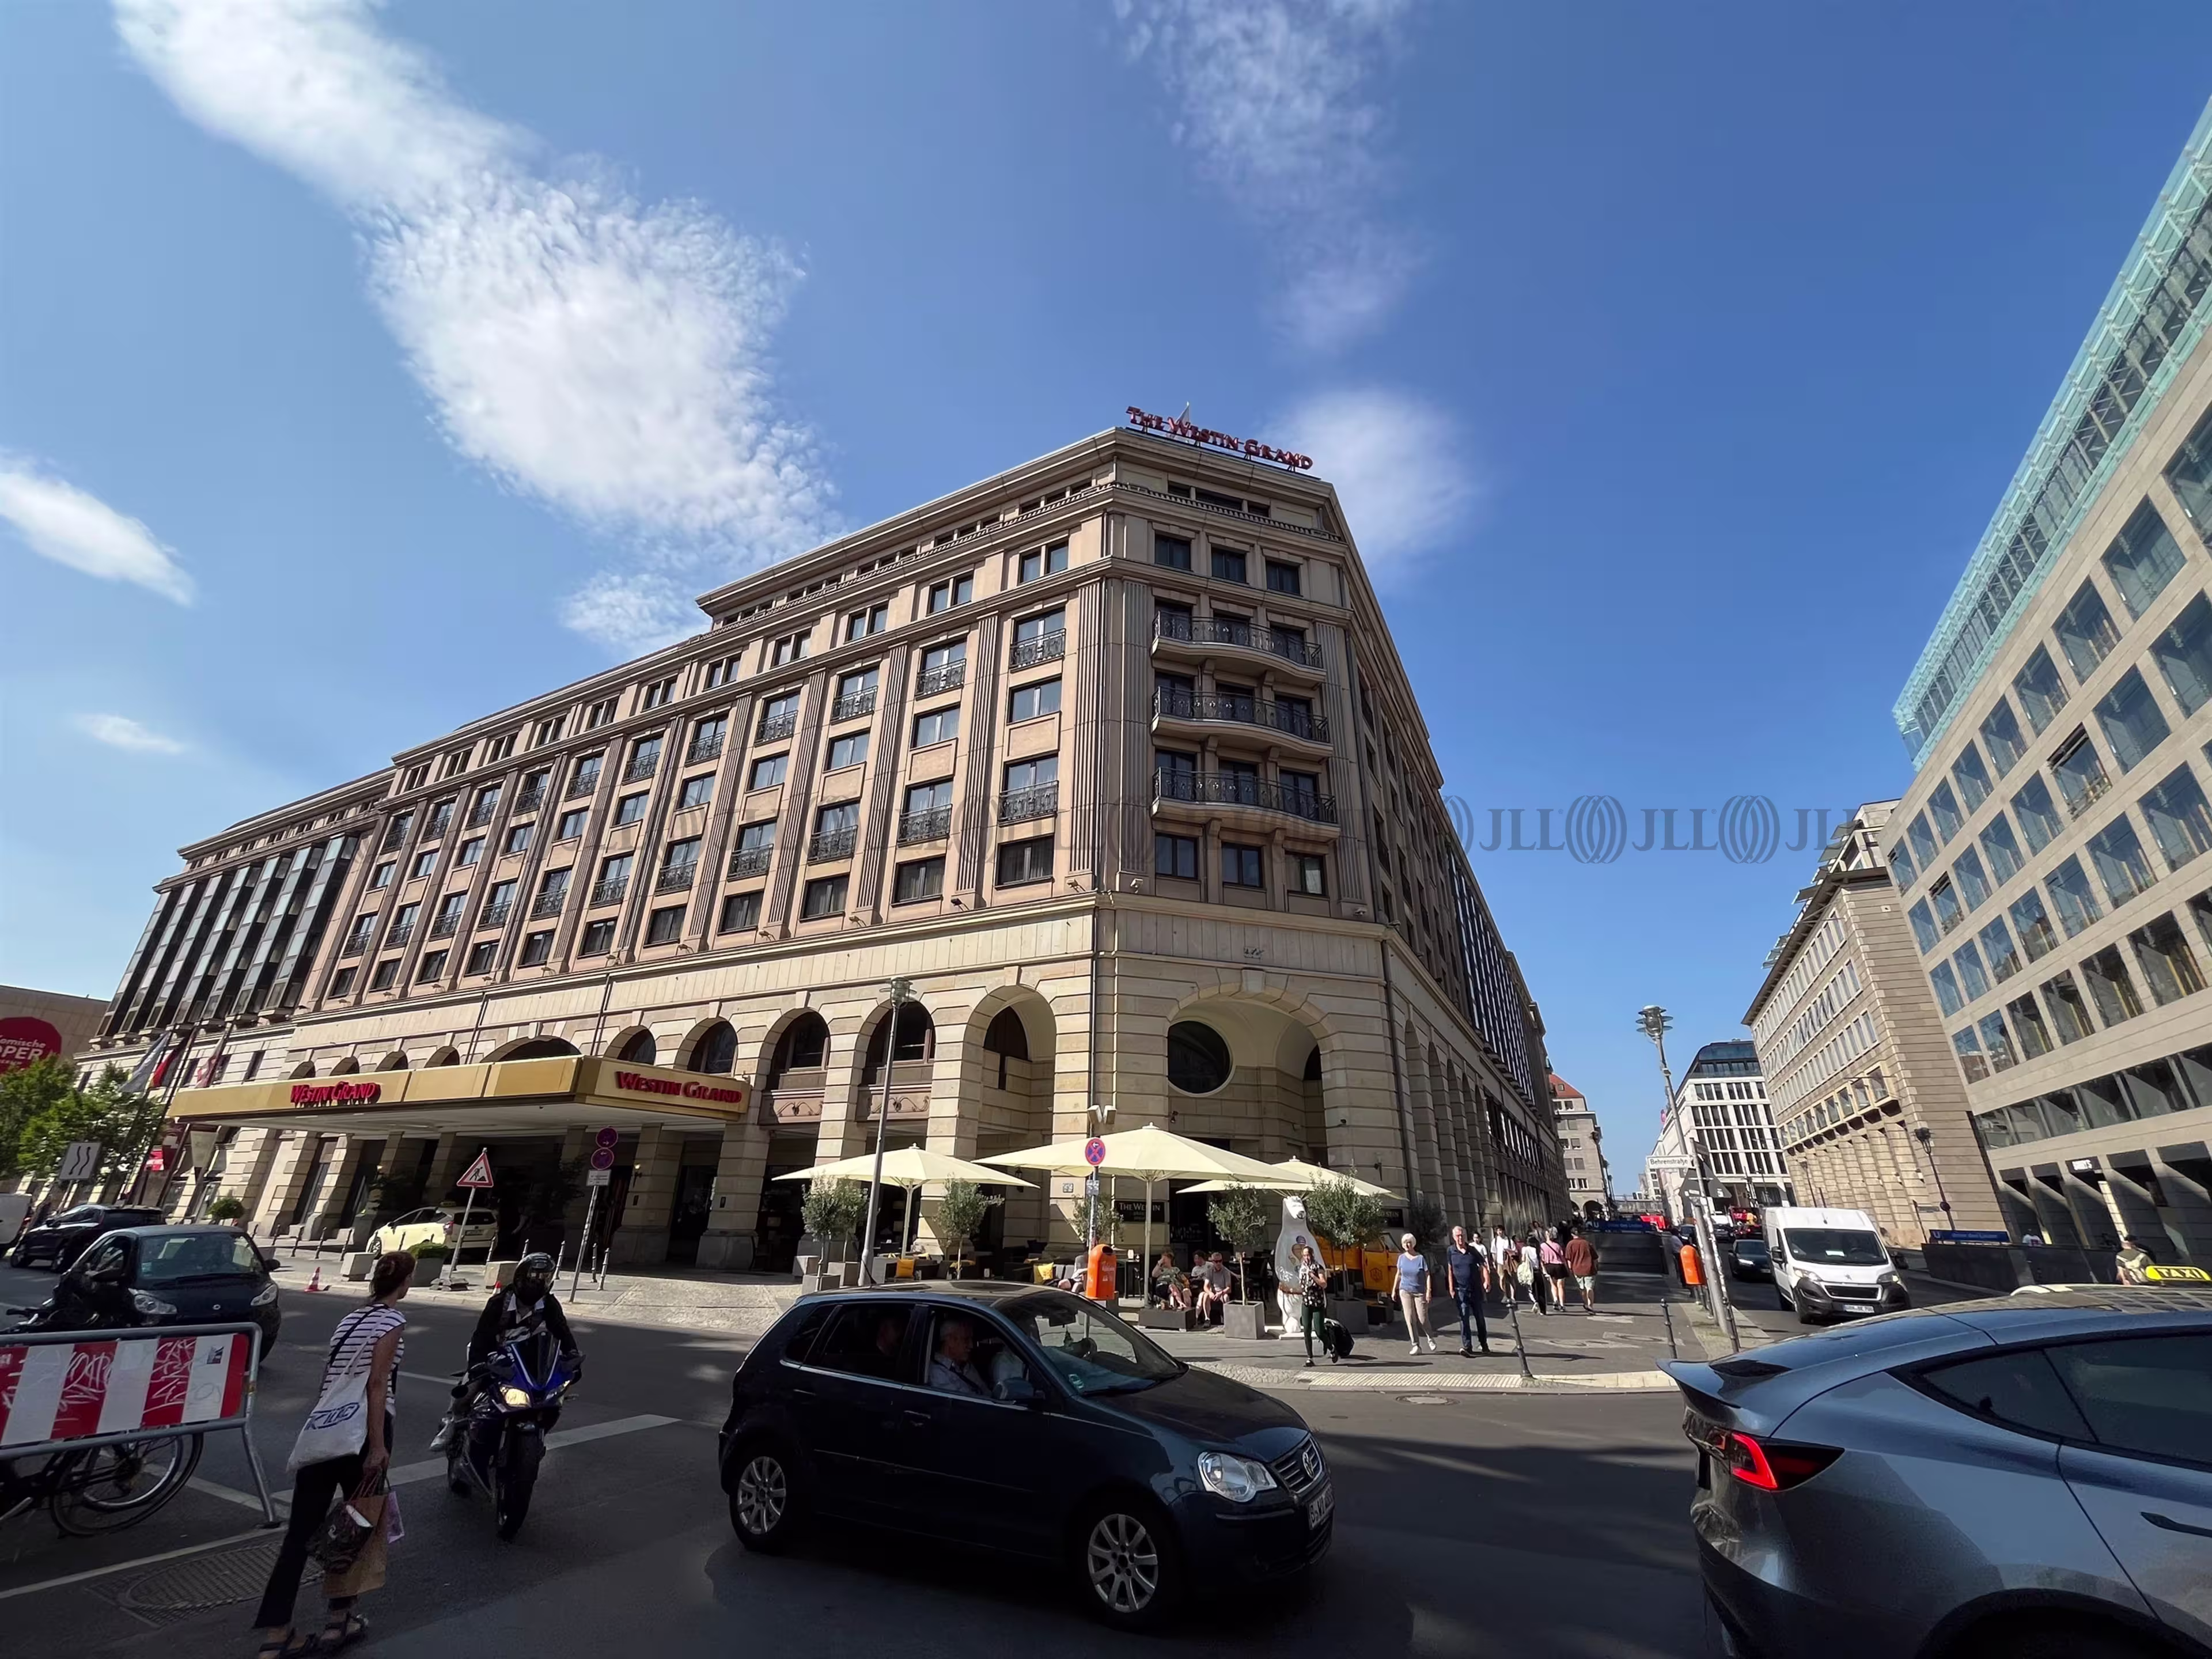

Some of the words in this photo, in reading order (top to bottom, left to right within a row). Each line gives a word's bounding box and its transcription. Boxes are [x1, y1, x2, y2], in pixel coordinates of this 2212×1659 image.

[1126, 406, 1164, 431] THE
[1167, 416, 1238, 450] WESTIN
[1244, 439, 1314, 470] GRAND
[0, 1035, 46, 1048] omische
[0, 1045, 43, 1060] PER
[331, 1081, 381, 1101] GRAND
[616, 1071, 682, 1096] WESTIN
[682, 1081, 743, 1104] GRAND
[1119, 1202, 1132, 1211] THE
[1133, 1203, 1161, 1211] WEIN
[2153, 1267, 2205, 1278] TAXI
